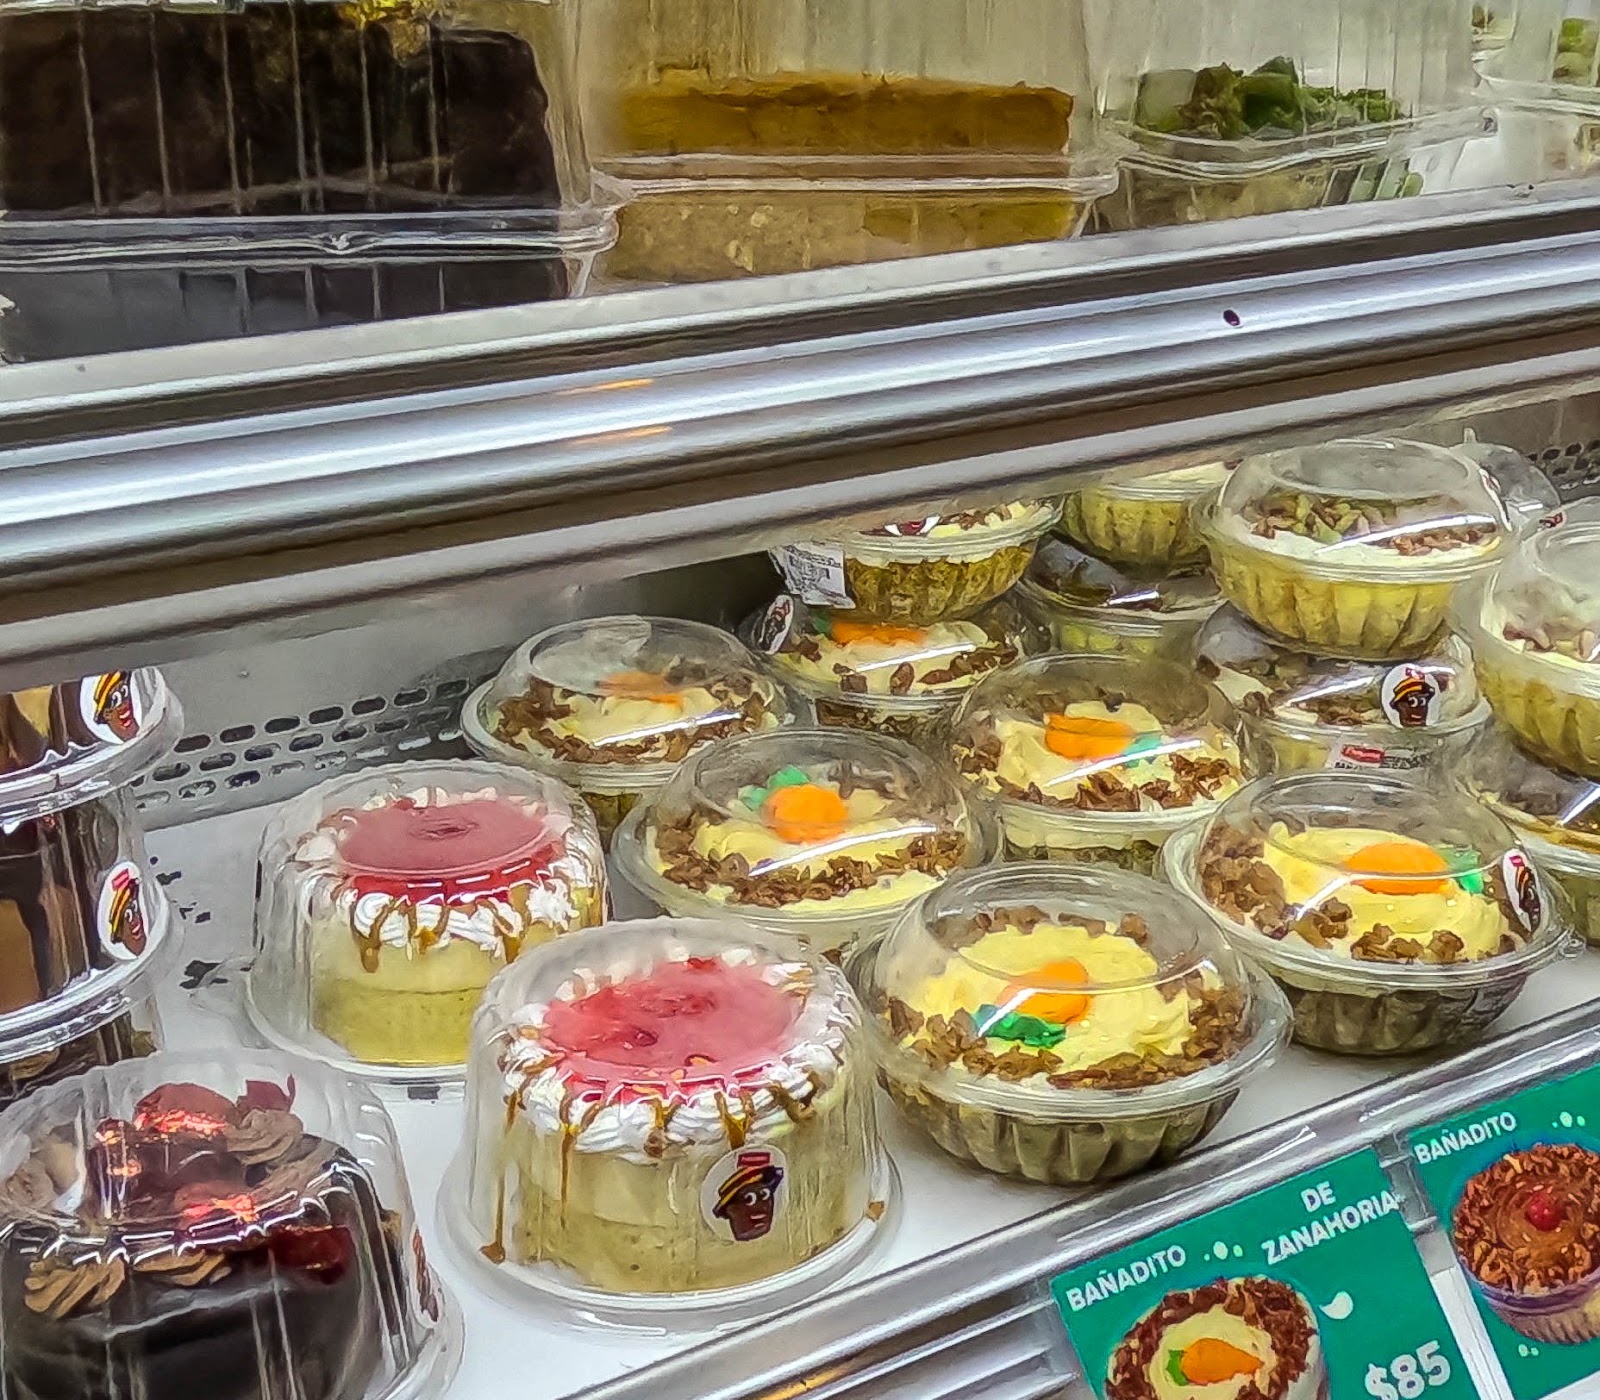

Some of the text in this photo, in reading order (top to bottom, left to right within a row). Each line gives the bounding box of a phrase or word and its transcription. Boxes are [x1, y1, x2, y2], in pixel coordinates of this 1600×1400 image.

[1413, 1111, 1517, 1165] BAÑADITO
[1260, 1189, 1399, 1266] ZANAHORIA
[1302, 1182, 1335, 1213] DE
[1065, 1245, 1187, 1313] BAÑADITO
